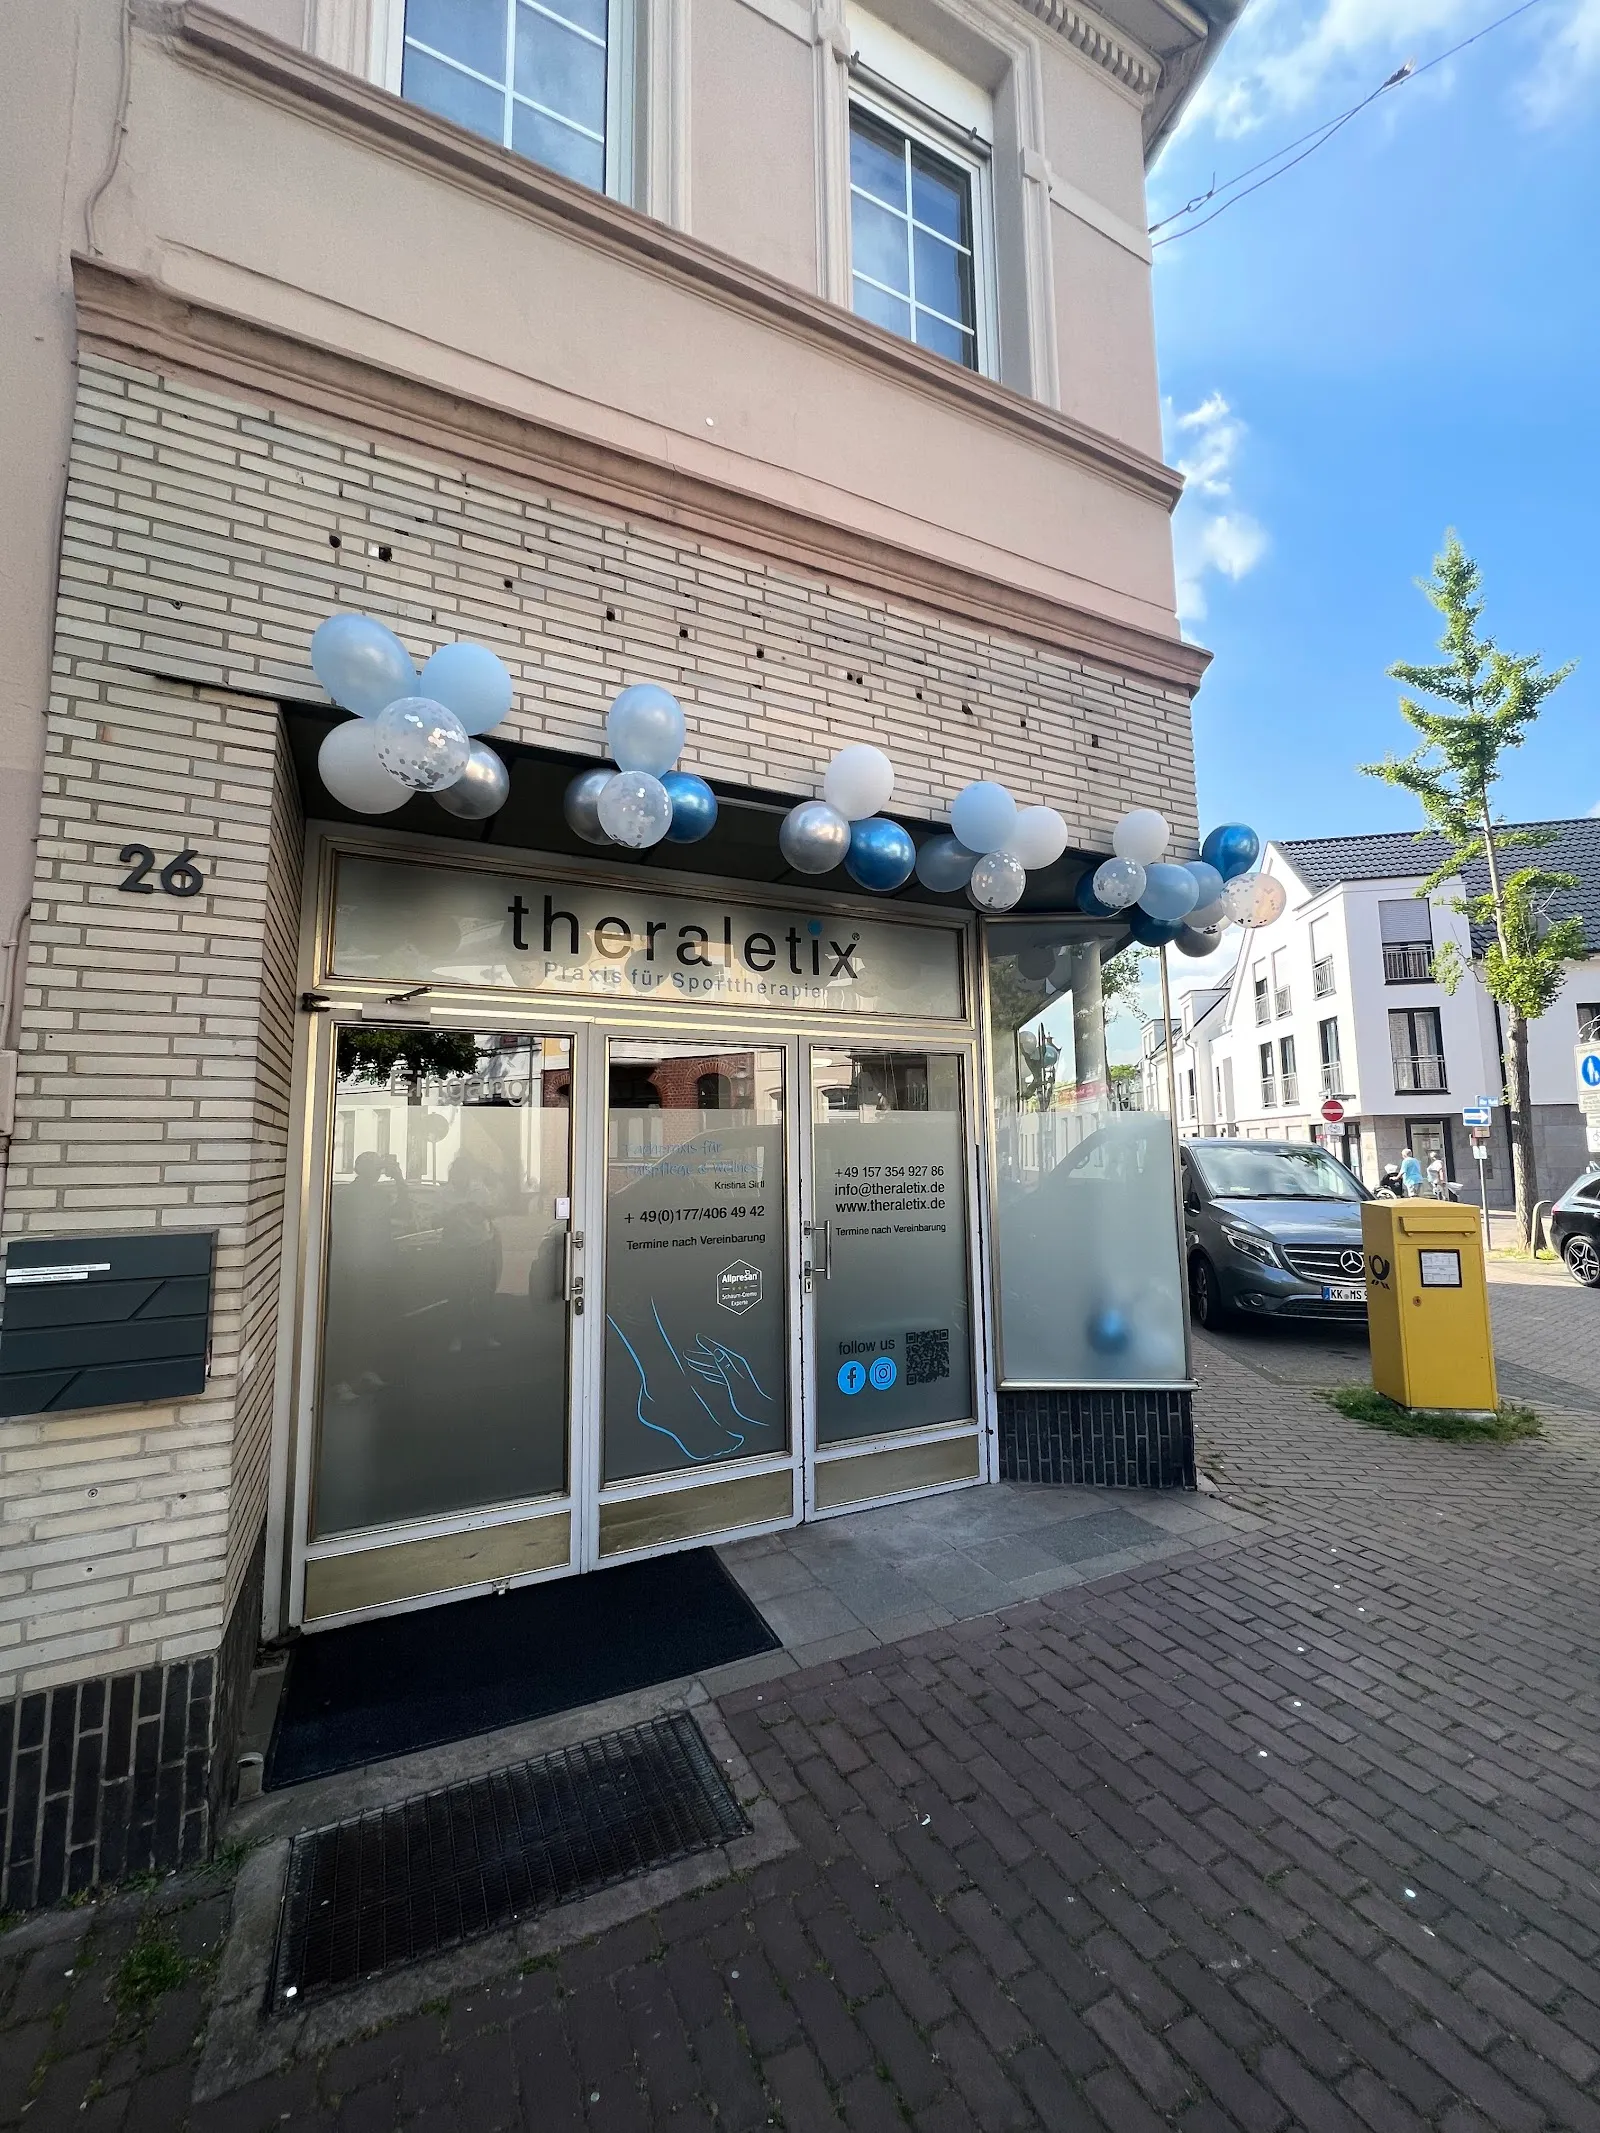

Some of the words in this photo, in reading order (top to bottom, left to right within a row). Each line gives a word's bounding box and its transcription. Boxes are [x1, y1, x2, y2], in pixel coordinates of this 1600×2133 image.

[119, 843, 203, 897] 26
[544, 961, 622, 984] Praxis
[631, 968, 663, 986] für
[390, 1069, 530, 1107] Eingang
[701, 1139, 722, 1155] für
[835, 1167, 859, 1178] +49
[862, 1166, 881, 1178] 157
[885, 1166, 905, 1177] 354
[908, 1166, 928, 1177] 927
[931, 1166, 944, 1176] 86
[714, 1181, 746, 1190] Kristina
[834, 1181, 945, 1197] info@theraletix.de
[835, 1198, 946, 1213] www.theraletix.de
[639, 1207, 727, 1225] 49(0)177/406
[731, 1206, 746, 1218] 49
[749, 1205, 765, 1217] 42
[835, 1227, 869, 1236] Termine
[872, 1225, 892, 1235] nach
[893, 1223, 946, 1233] Vereinbarung
[626, 1240, 669, 1251] Termine
[672, 1236, 697, 1248] nach
[700, 1232, 766, 1245] Vereinbarung
[721, 1273, 758, 1284] Allpresan
[1331, 1289, 1343, 1300] KK
[1350, 1290, 1362, 1300] MS
[839, 1340, 876, 1356] follow
[880, 1339, 896, 1351] us
